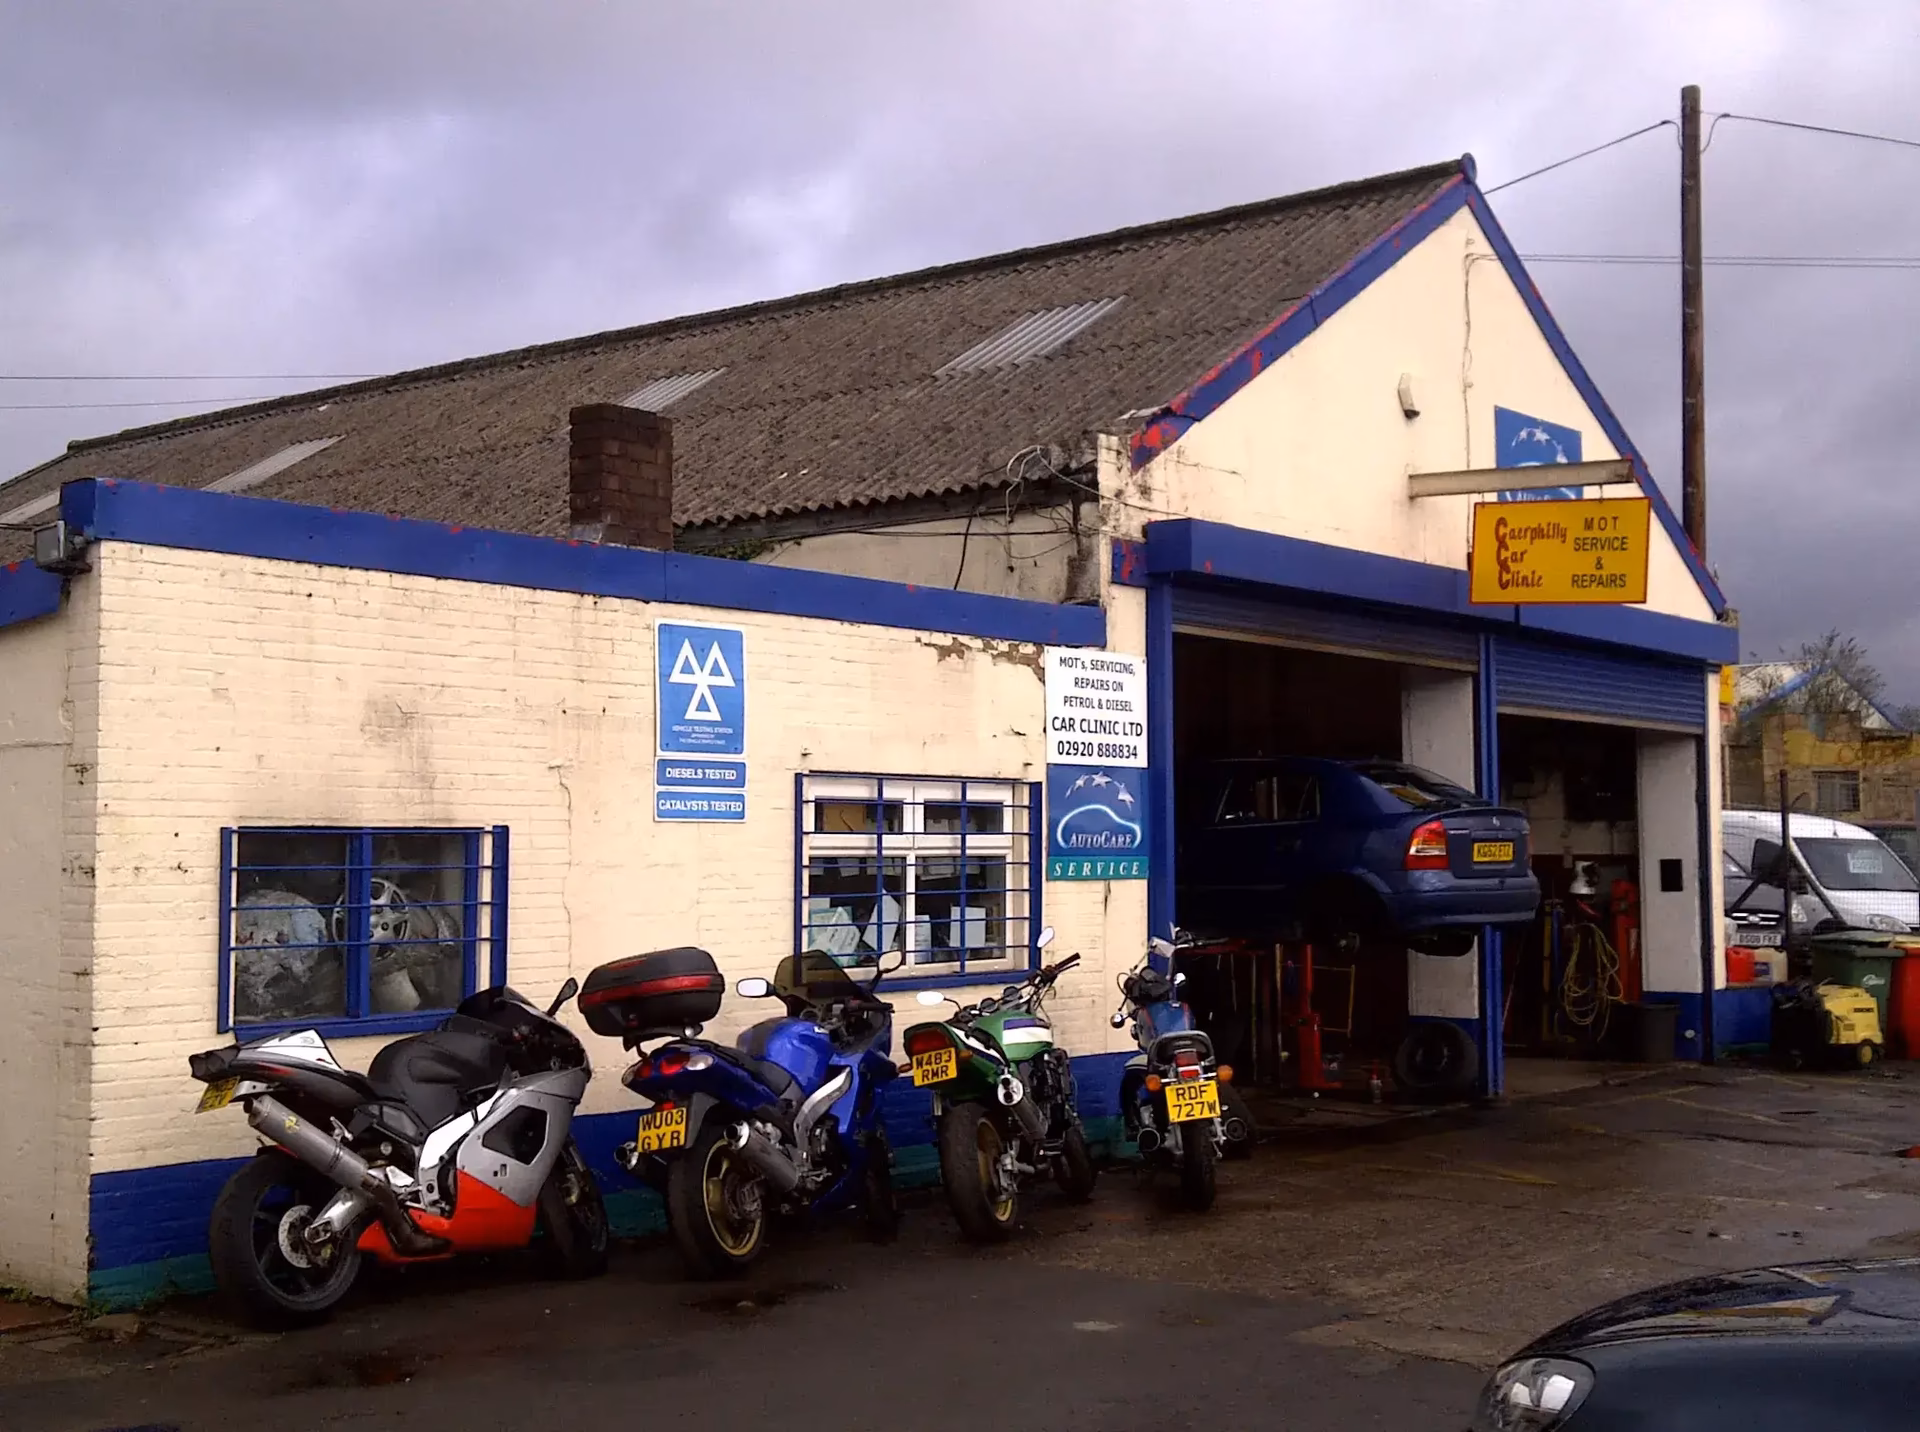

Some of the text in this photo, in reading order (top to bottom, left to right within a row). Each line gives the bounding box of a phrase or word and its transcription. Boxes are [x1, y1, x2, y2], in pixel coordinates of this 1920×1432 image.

[1495, 517, 1567, 545] Caerphilly
[1574, 536, 1628, 552] SERVICE
[1496, 540, 1528, 567] Car
[1595, 556, 1604, 570] &
[1499, 563, 1544, 590] Clinic
[1572, 573, 1627, 589] REPAIRS
[1074, 677, 1124, 692] REPAIRS ON
[1064, 695, 1133, 712] PETROL & DIESEL
[1052, 716, 1143, 737] CAR CLINIC LTD
[1057, 740, 1138, 759] 02920 888834
[666, 767, 737, 780] DIESELS TESTED
[659, 799, 743, 812] CATALYSTS TESTED
[1054, 862, 1139, 877] SERVICE
[916, 1050, 952, 1070] W483
[922, 1065, 949, 1083] RMR
[1176, 1083, 1211, 1101] RDF
[1172, 1100, 1217, 1118] 727W
[642, 1110, 684, 1131] WU03
[641, 1130, 681, 1151] GYR
